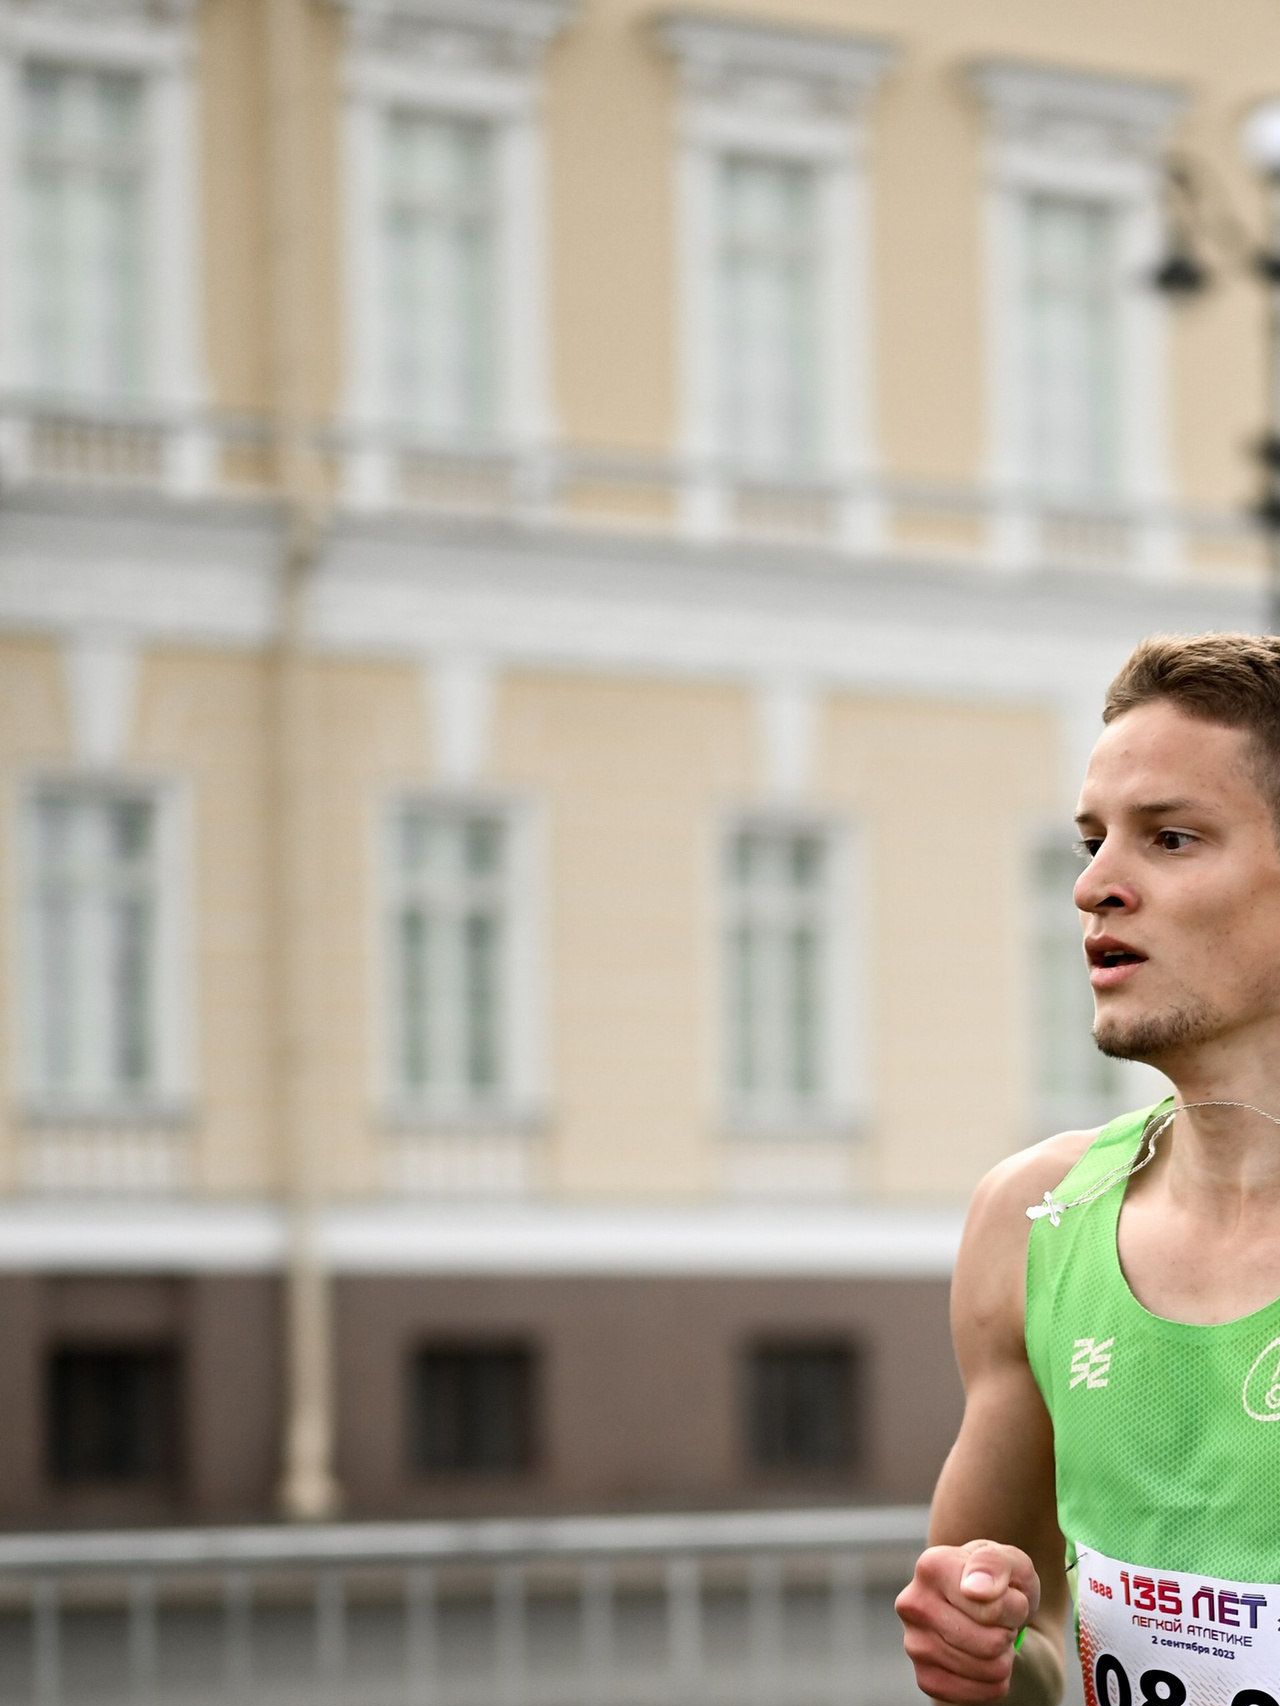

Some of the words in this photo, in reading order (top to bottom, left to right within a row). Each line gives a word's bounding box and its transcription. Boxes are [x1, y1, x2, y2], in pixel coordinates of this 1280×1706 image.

[1089, 1577, 1113, 1600] 1888
[1120, 1570, 1183, 1616] 135
[1192, 1585, 1268, 1629] ЛЕТ
[1132, 1614, 1183, 1634] ЛЕГКОЙ
[1186, 1624, 1253, 1648] АТЛЕТИКЕ
[1151, 1635, 1159, 1645] 2
[1160, 1638, 1210, 1655] сентября
[1212, 1646, 1236, 1661] 2023
